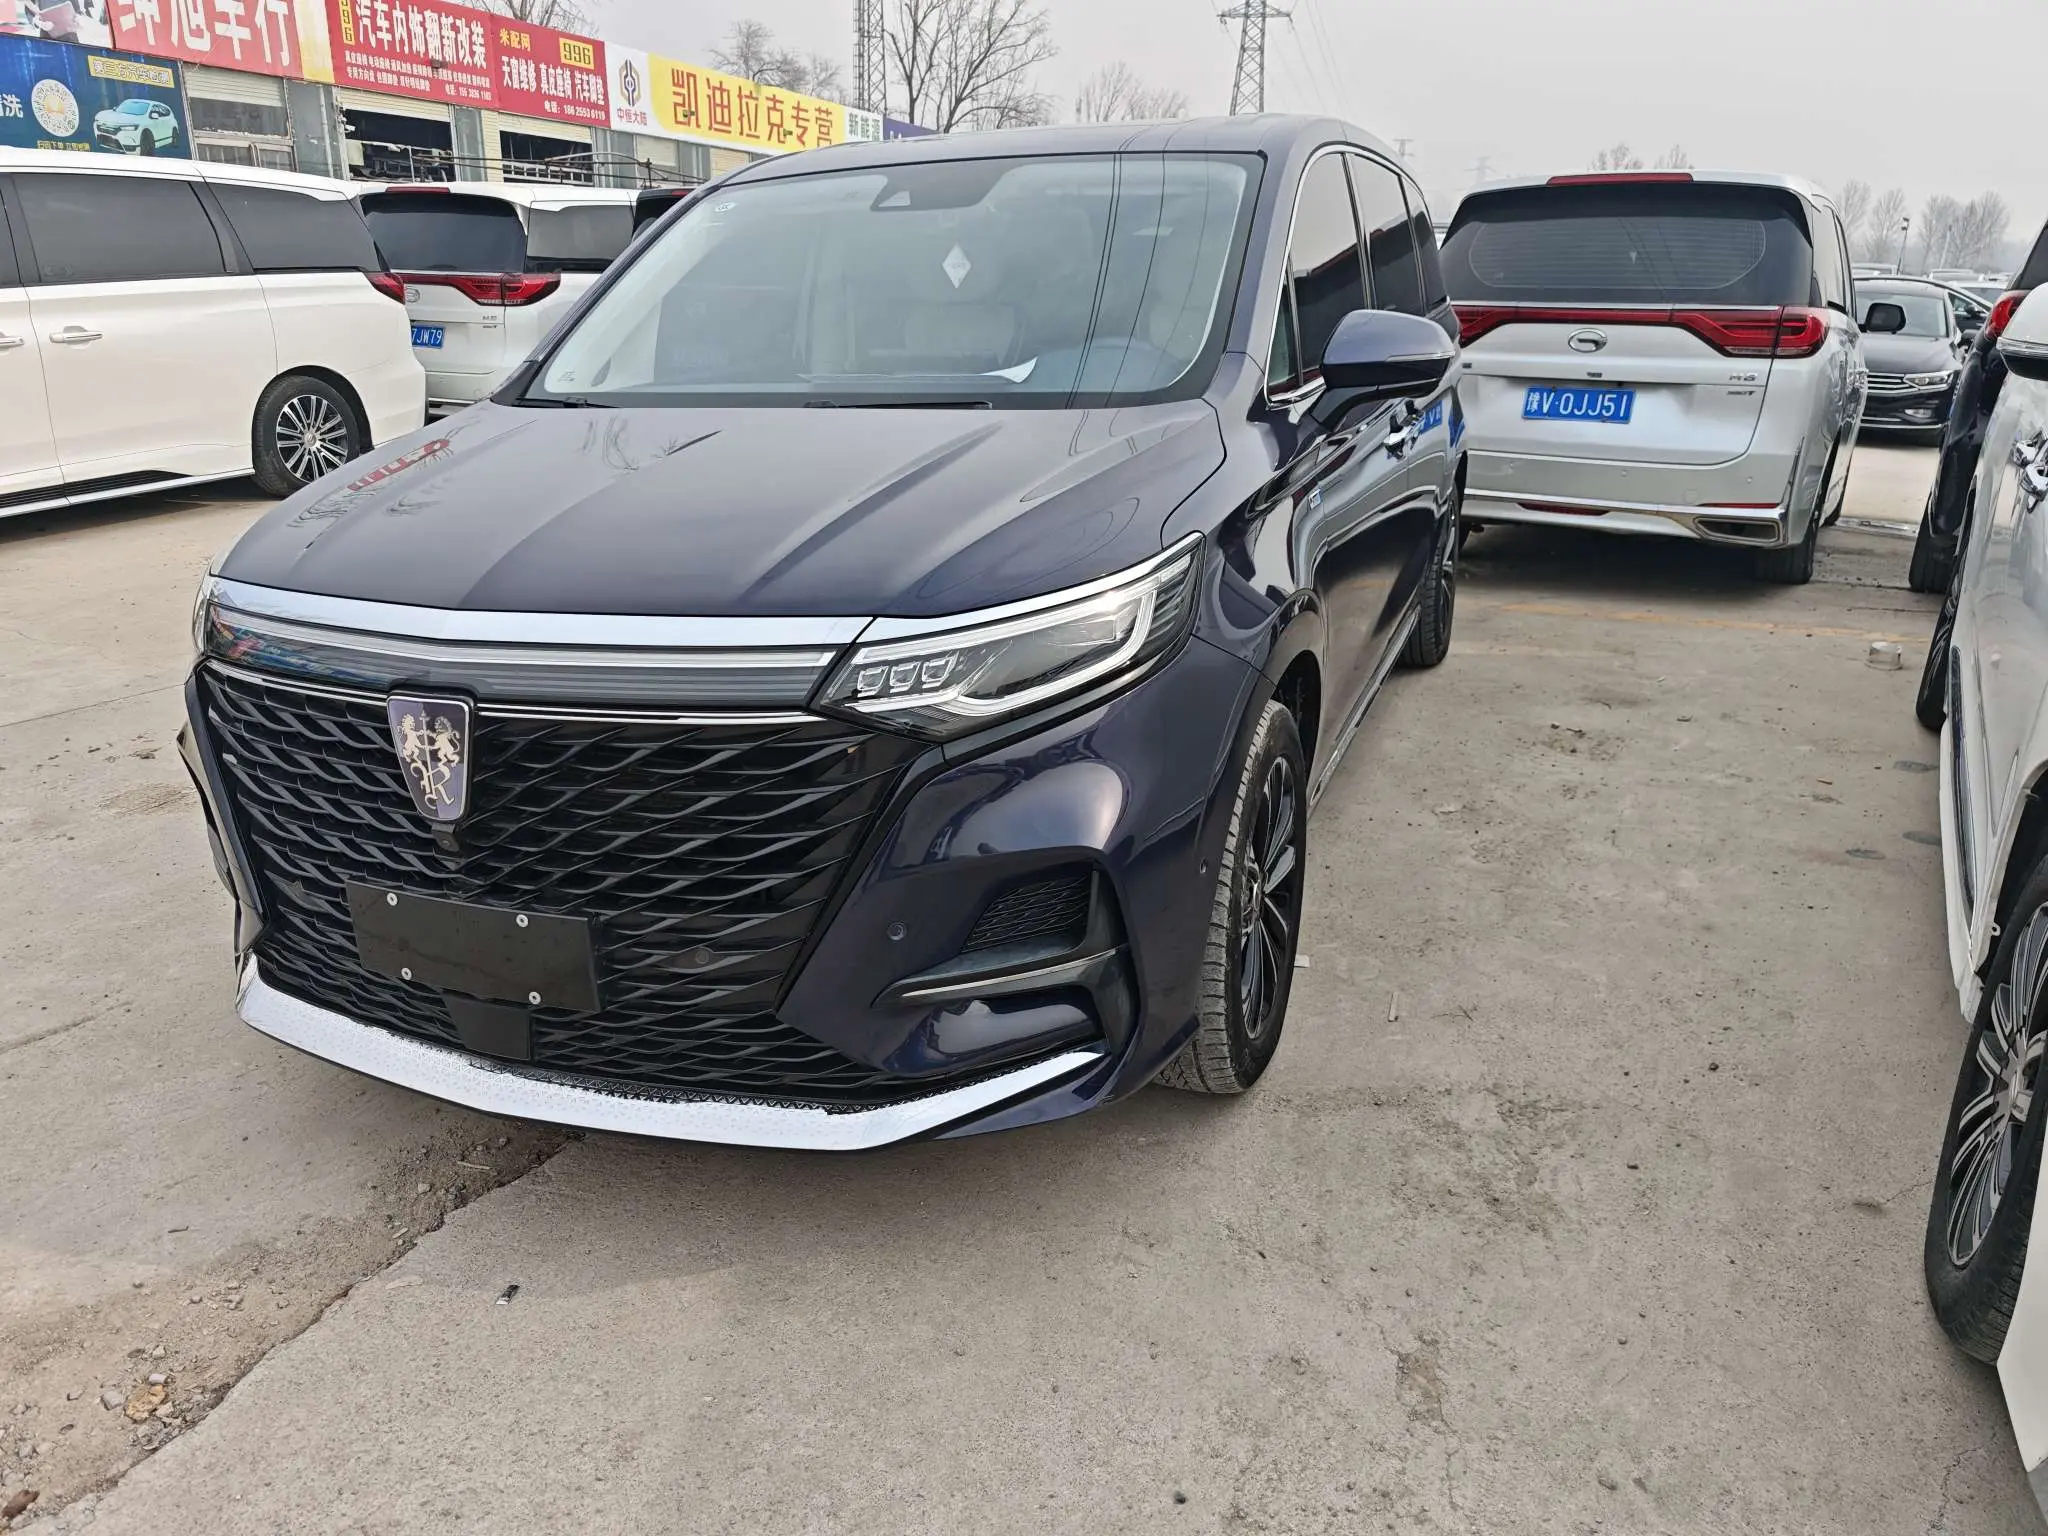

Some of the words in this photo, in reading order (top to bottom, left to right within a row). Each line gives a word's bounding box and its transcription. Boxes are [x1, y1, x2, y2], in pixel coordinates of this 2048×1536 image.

[563, 42, 591, 65] 996
[501, 55, 537, 93] 天窗维修
[0, 93, 24, 119] 洗
[671, 67, 833, 147] 凯迪拉克专营
